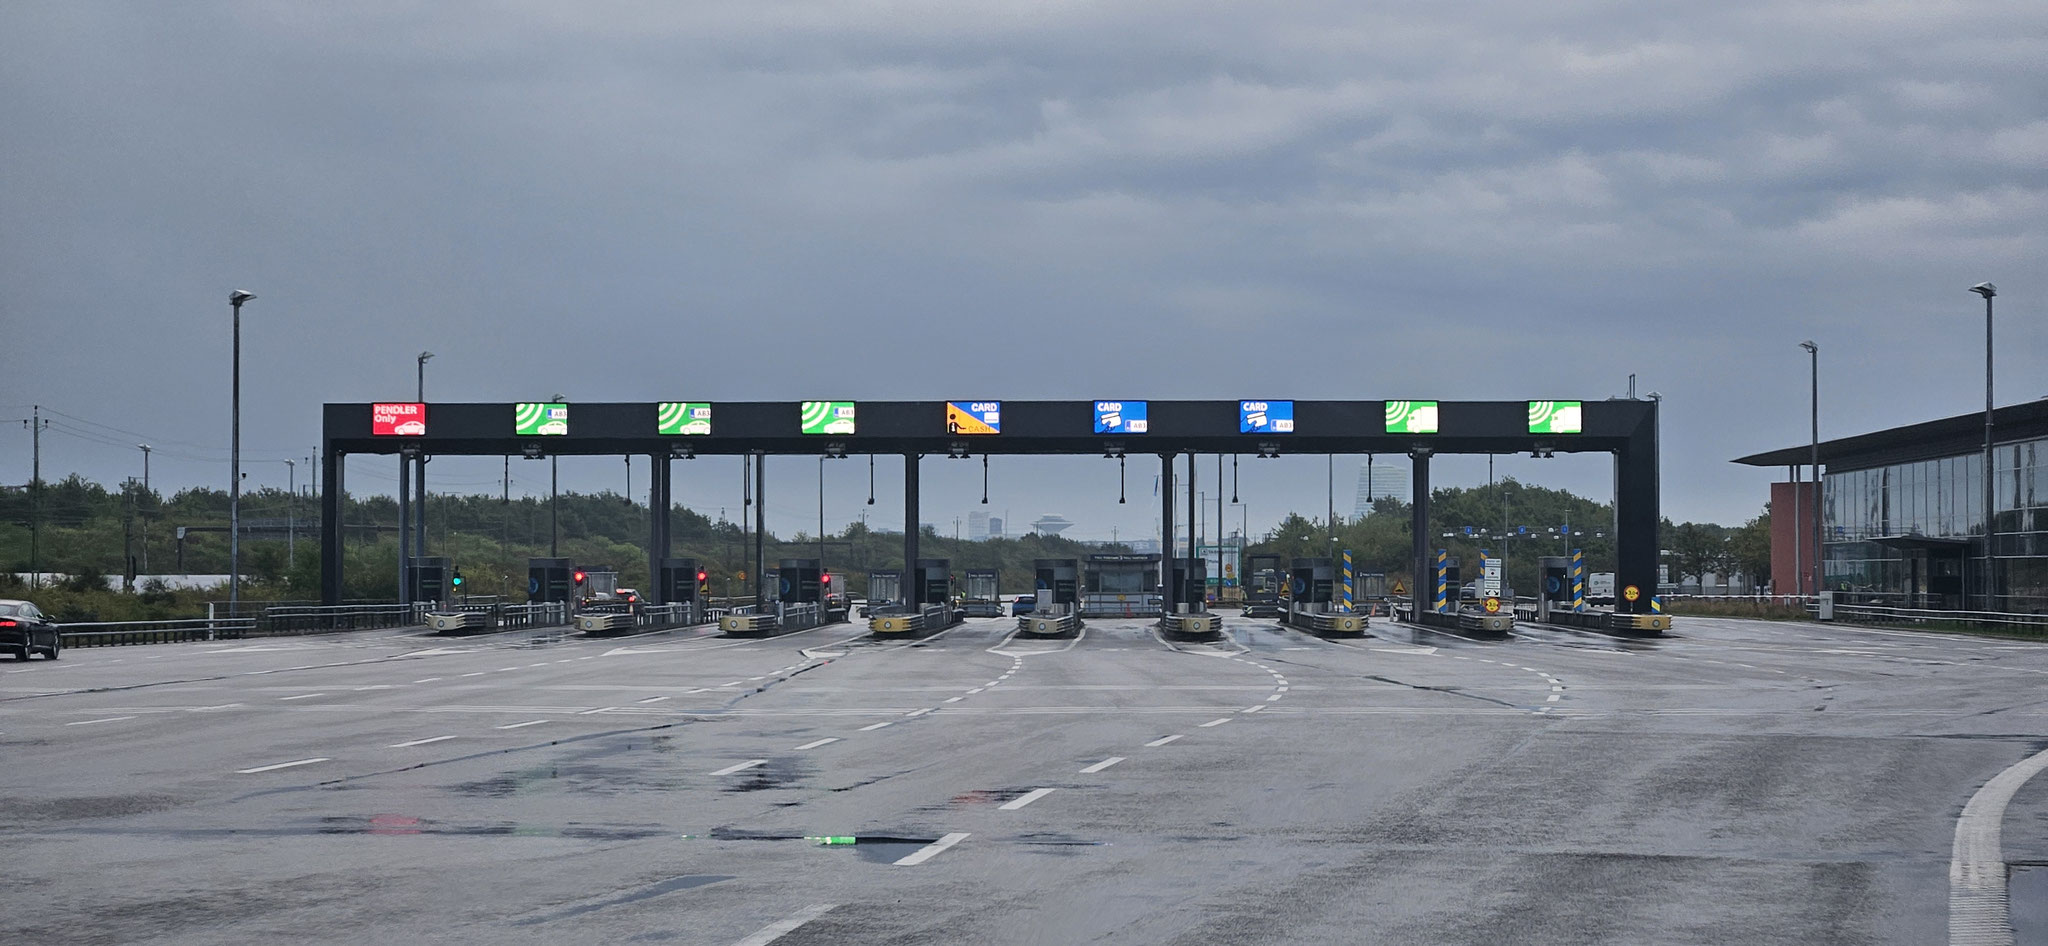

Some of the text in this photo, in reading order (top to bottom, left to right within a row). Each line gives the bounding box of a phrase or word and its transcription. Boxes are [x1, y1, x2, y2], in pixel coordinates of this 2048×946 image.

[375, 405, 418, 415] PENDLER
[971, 402, 998, 412] CARD
[1097, 402, 1122, 412] CARD
[1243, 402, 1268, 412] CARD
[375, 414, 397, 424] Only
[968, 425, 991, 433] CASH
